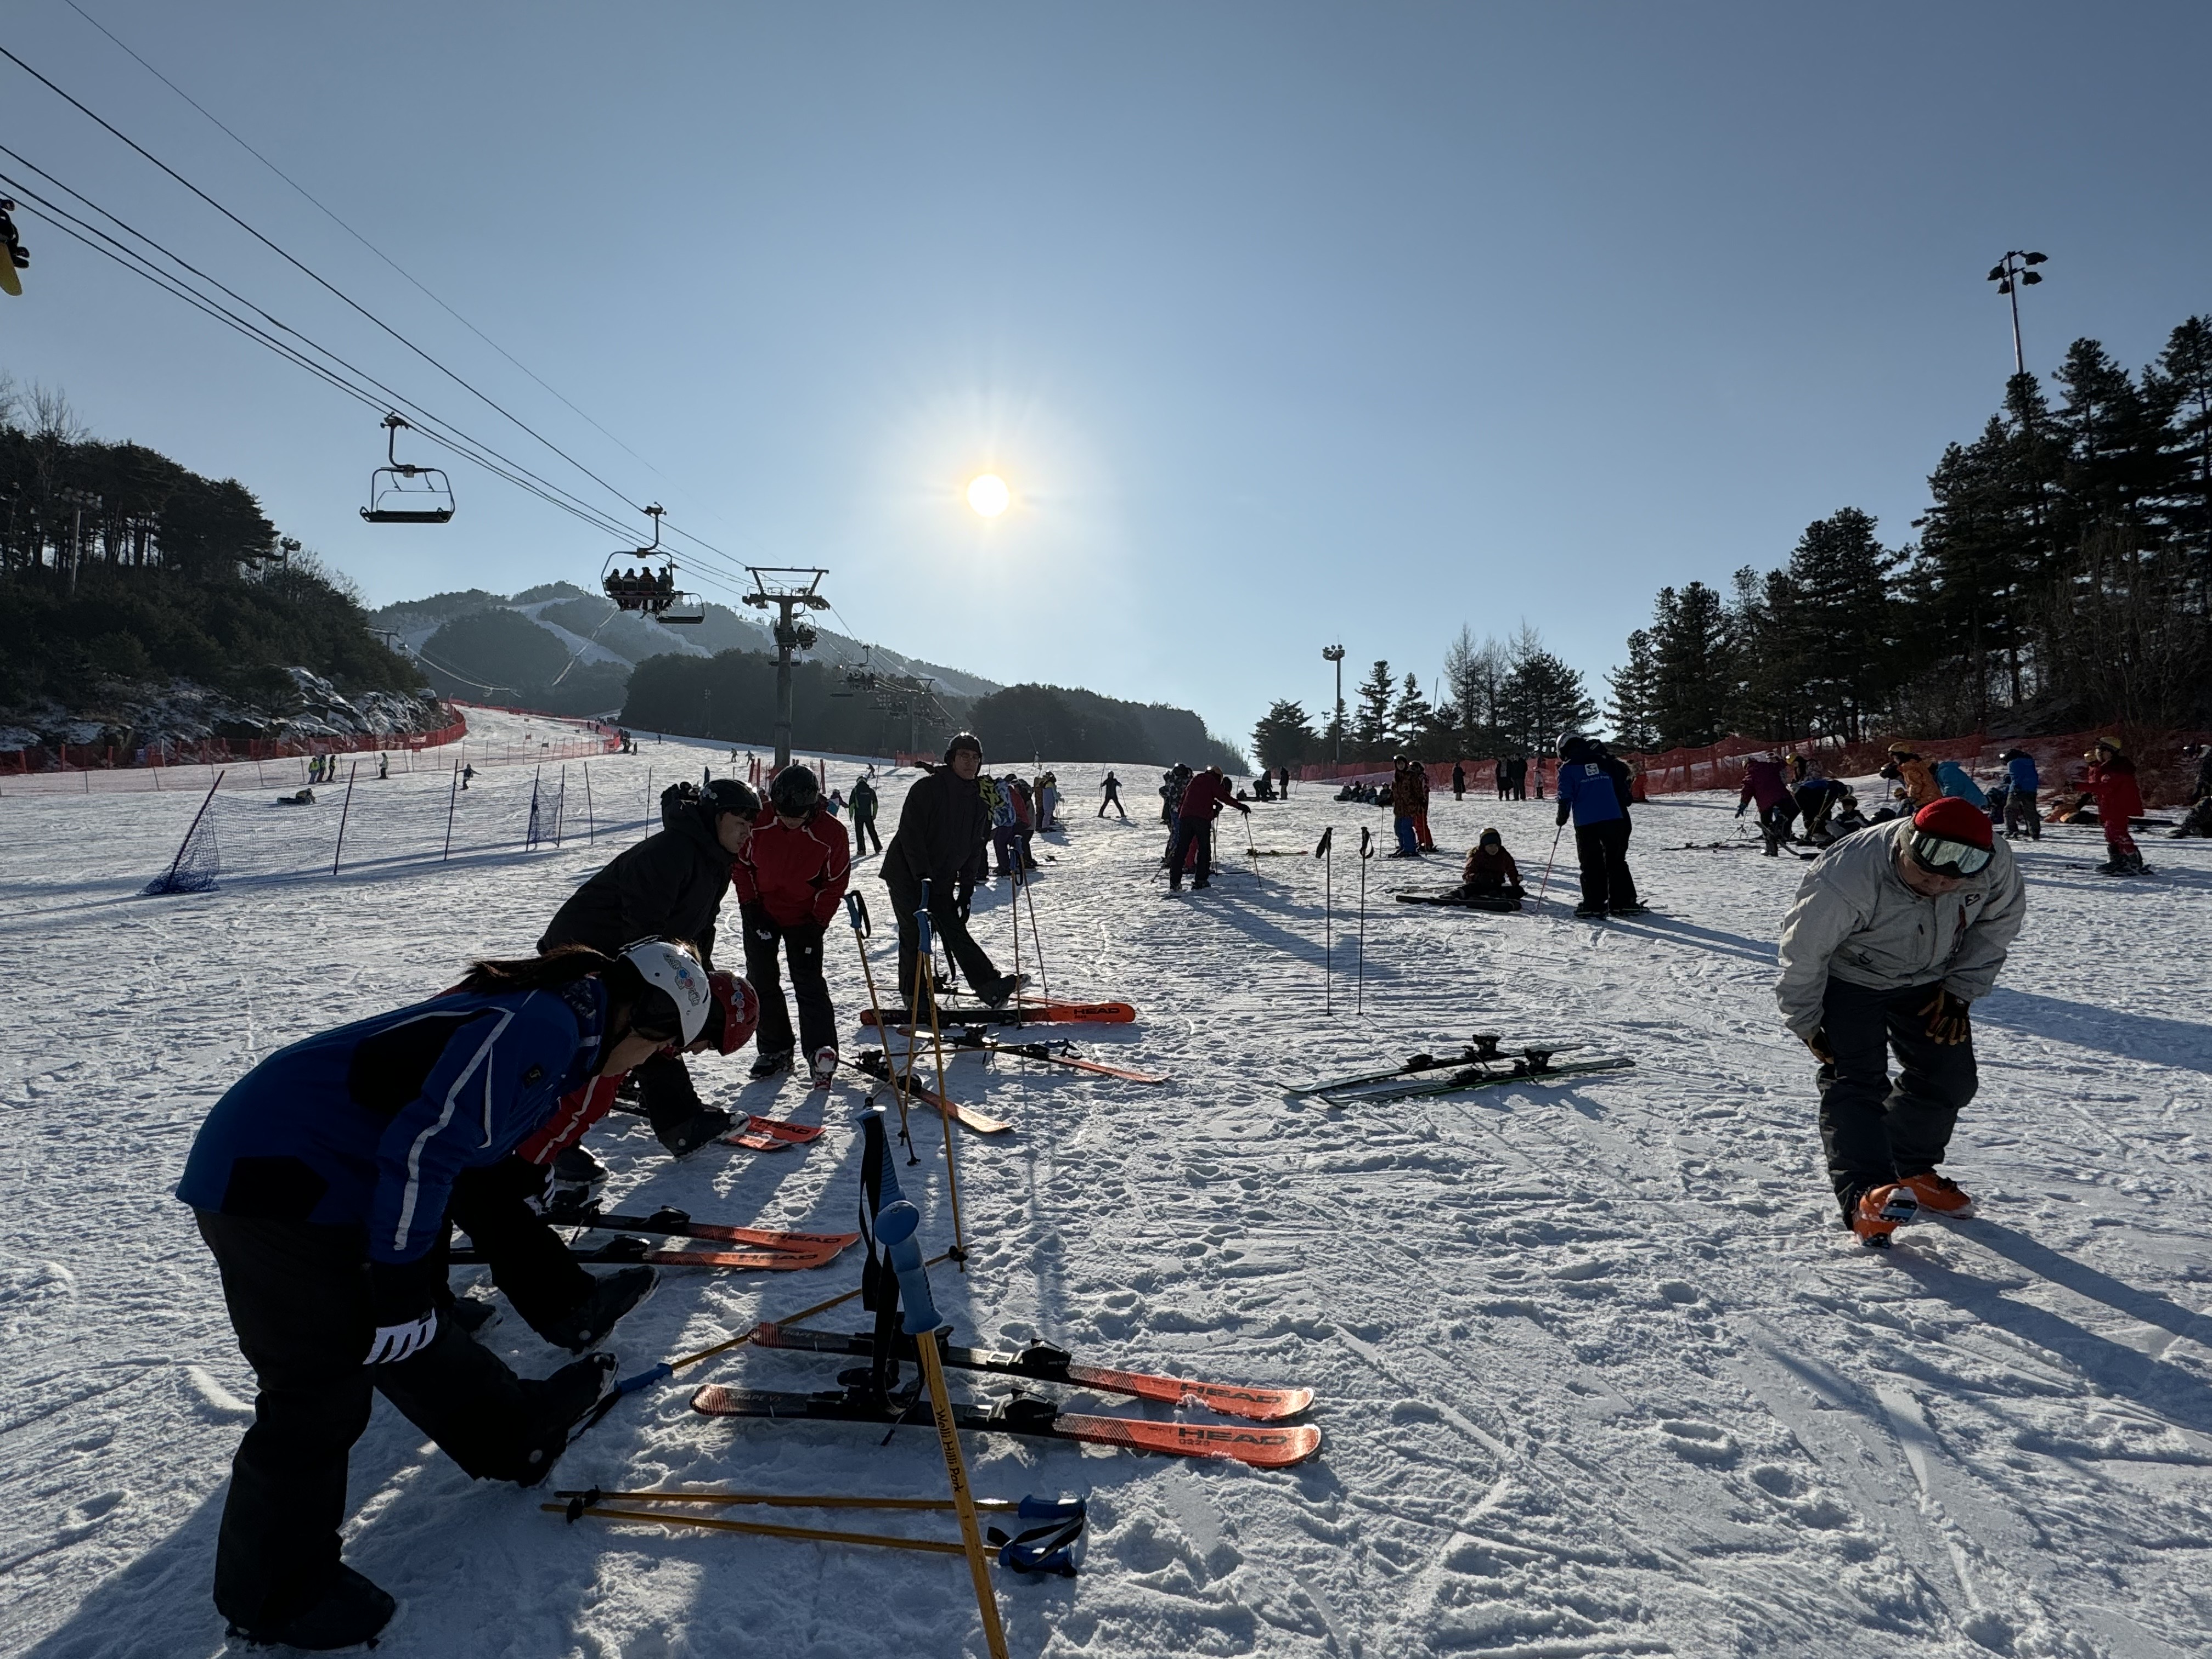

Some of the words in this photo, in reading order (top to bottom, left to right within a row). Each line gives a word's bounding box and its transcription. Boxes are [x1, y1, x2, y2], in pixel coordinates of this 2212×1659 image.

[769, 1232, 842, 1243] HEAD
[1180, 1383, 1282, 1403] HEAD
[935, 1408, 951, 1438] Welli
[1178, 1427, 1288, 1445] HEAD
[943, 1441, 958, 1464] Hilli
[950, 1467, 964, 1493] Park
